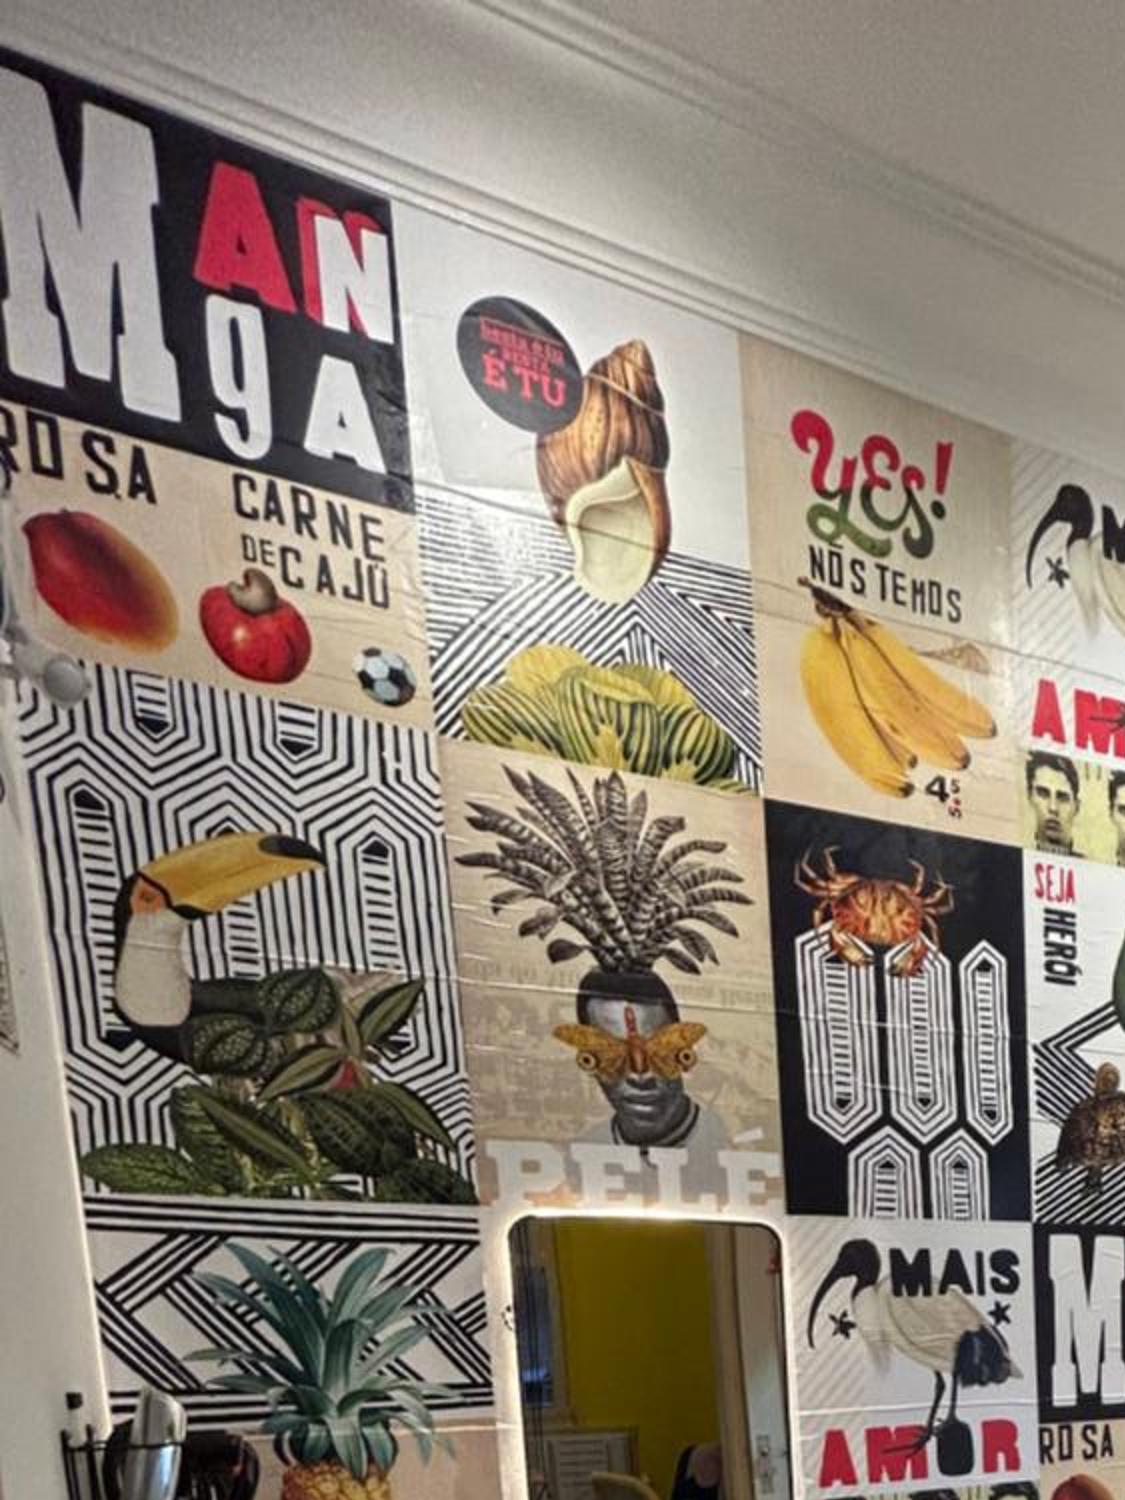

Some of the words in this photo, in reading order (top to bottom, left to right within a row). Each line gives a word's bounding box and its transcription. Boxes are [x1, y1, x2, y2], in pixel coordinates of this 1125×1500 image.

[232, 473, 386, 562] CARNE
[241, 533, 275, 567] DE
[874, 562, 963, 624] TEMOS
[1034, 863, 1076, 903] SEJA
[1043, 907, 1082, 986] HERÓI
[485, 1127, 785, 1212] PELÉ
[889, 1248, 1021, 1298] MAIS
[819, 1418, 1022, 1488] AMOR
[1039, 1424, 1114, 1464] ROSA
